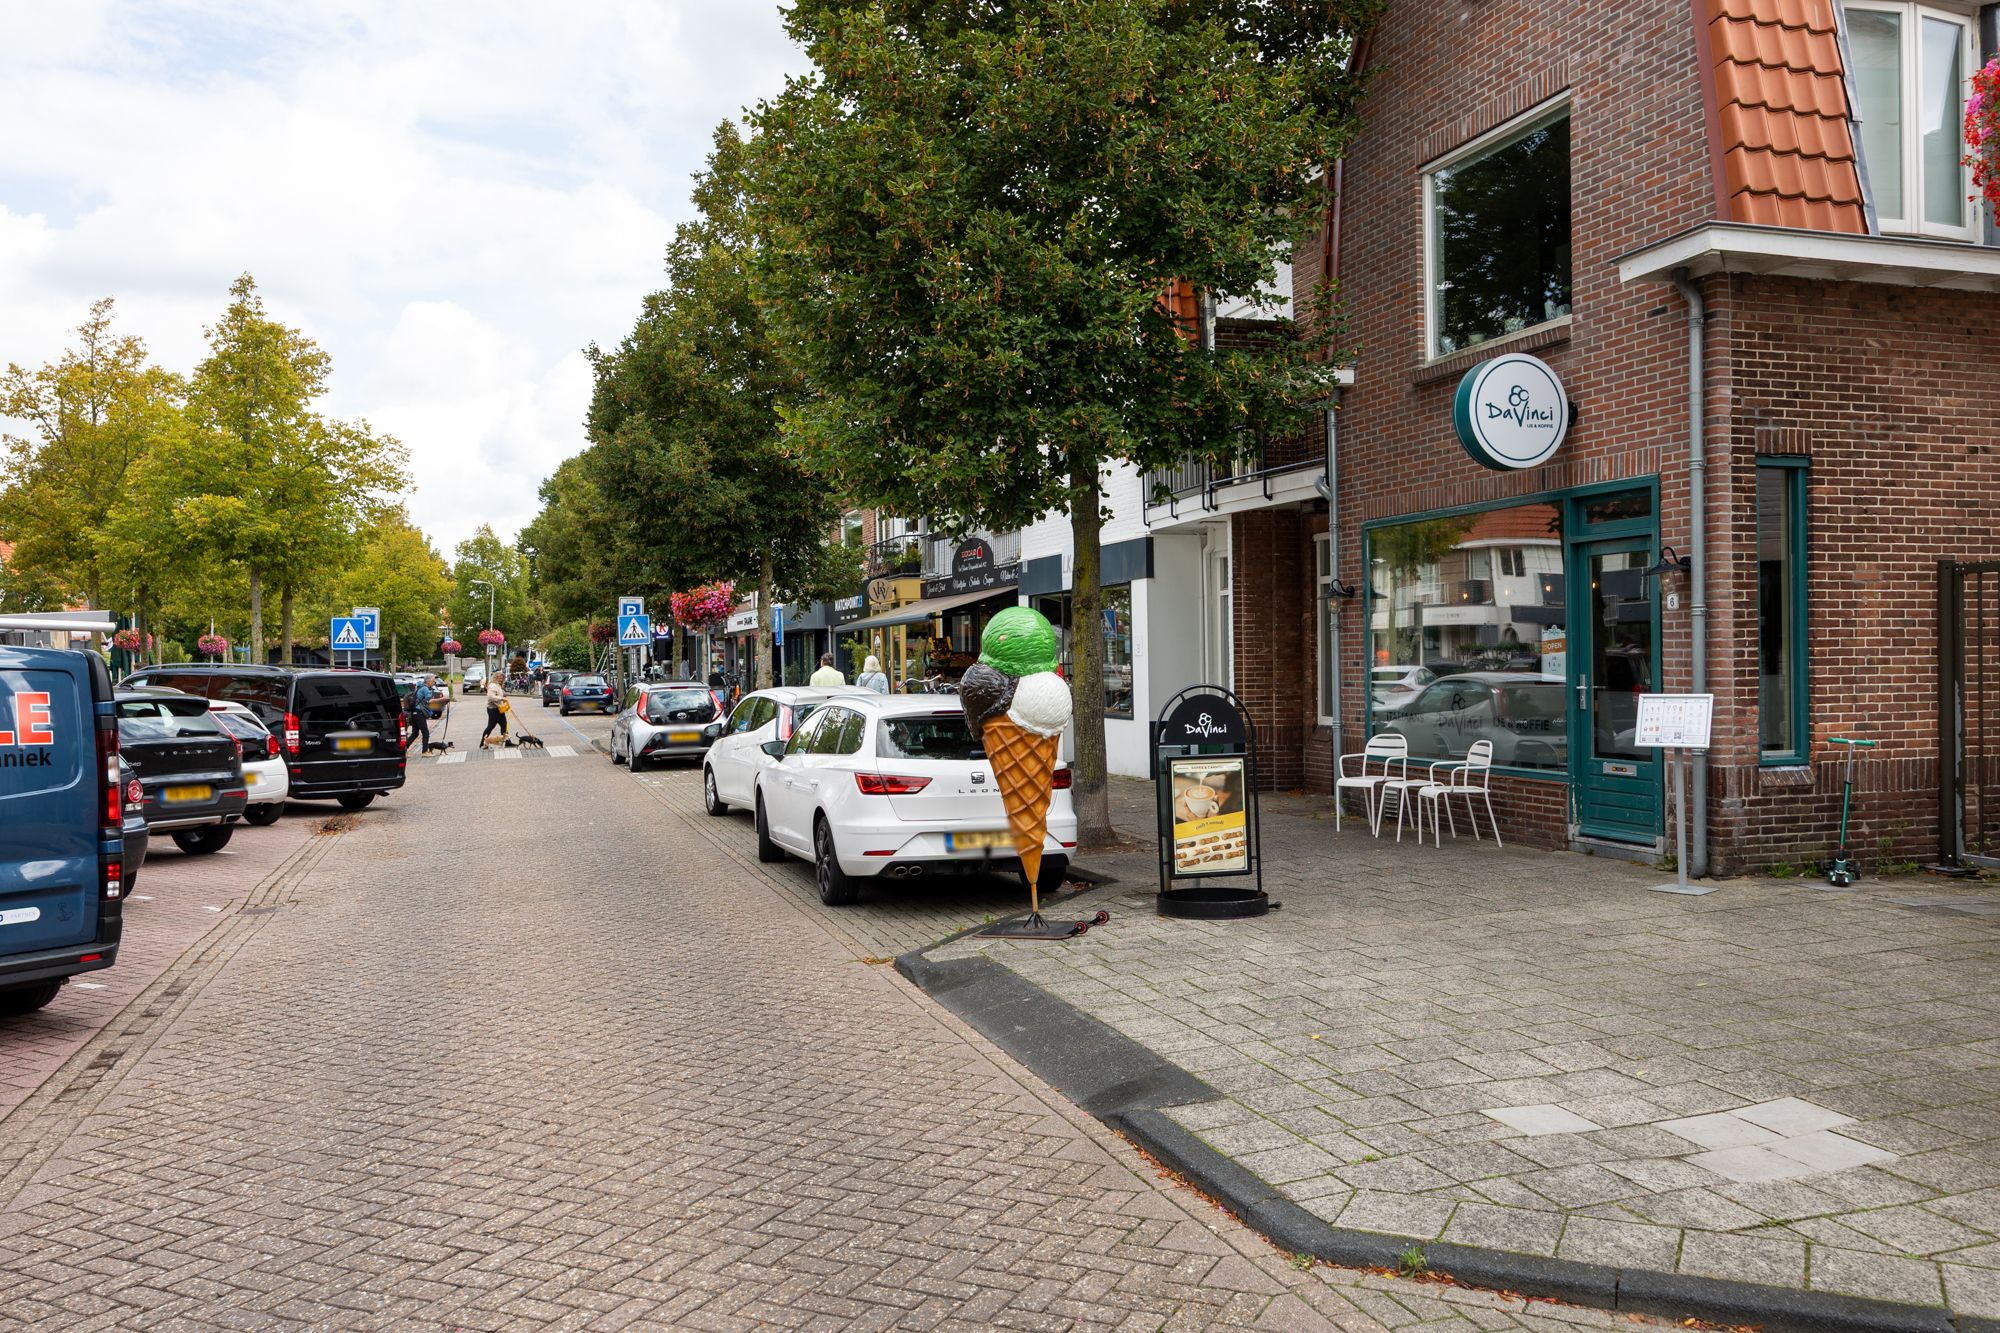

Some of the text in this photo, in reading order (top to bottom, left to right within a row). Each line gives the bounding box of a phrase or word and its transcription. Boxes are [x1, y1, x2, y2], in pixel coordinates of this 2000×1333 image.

[1485, 401, 1553, 427] DaVinci
[1670, 597, 1674, 607] 6
[627, 606, 636, 615] P
[1547, 642, 1562, 650] OPEN
[1184, 722, 1227, 738] DaVinci
[1516, 719, 1550, 731] KOFFIE
[0, 747, 52, 767] niek
